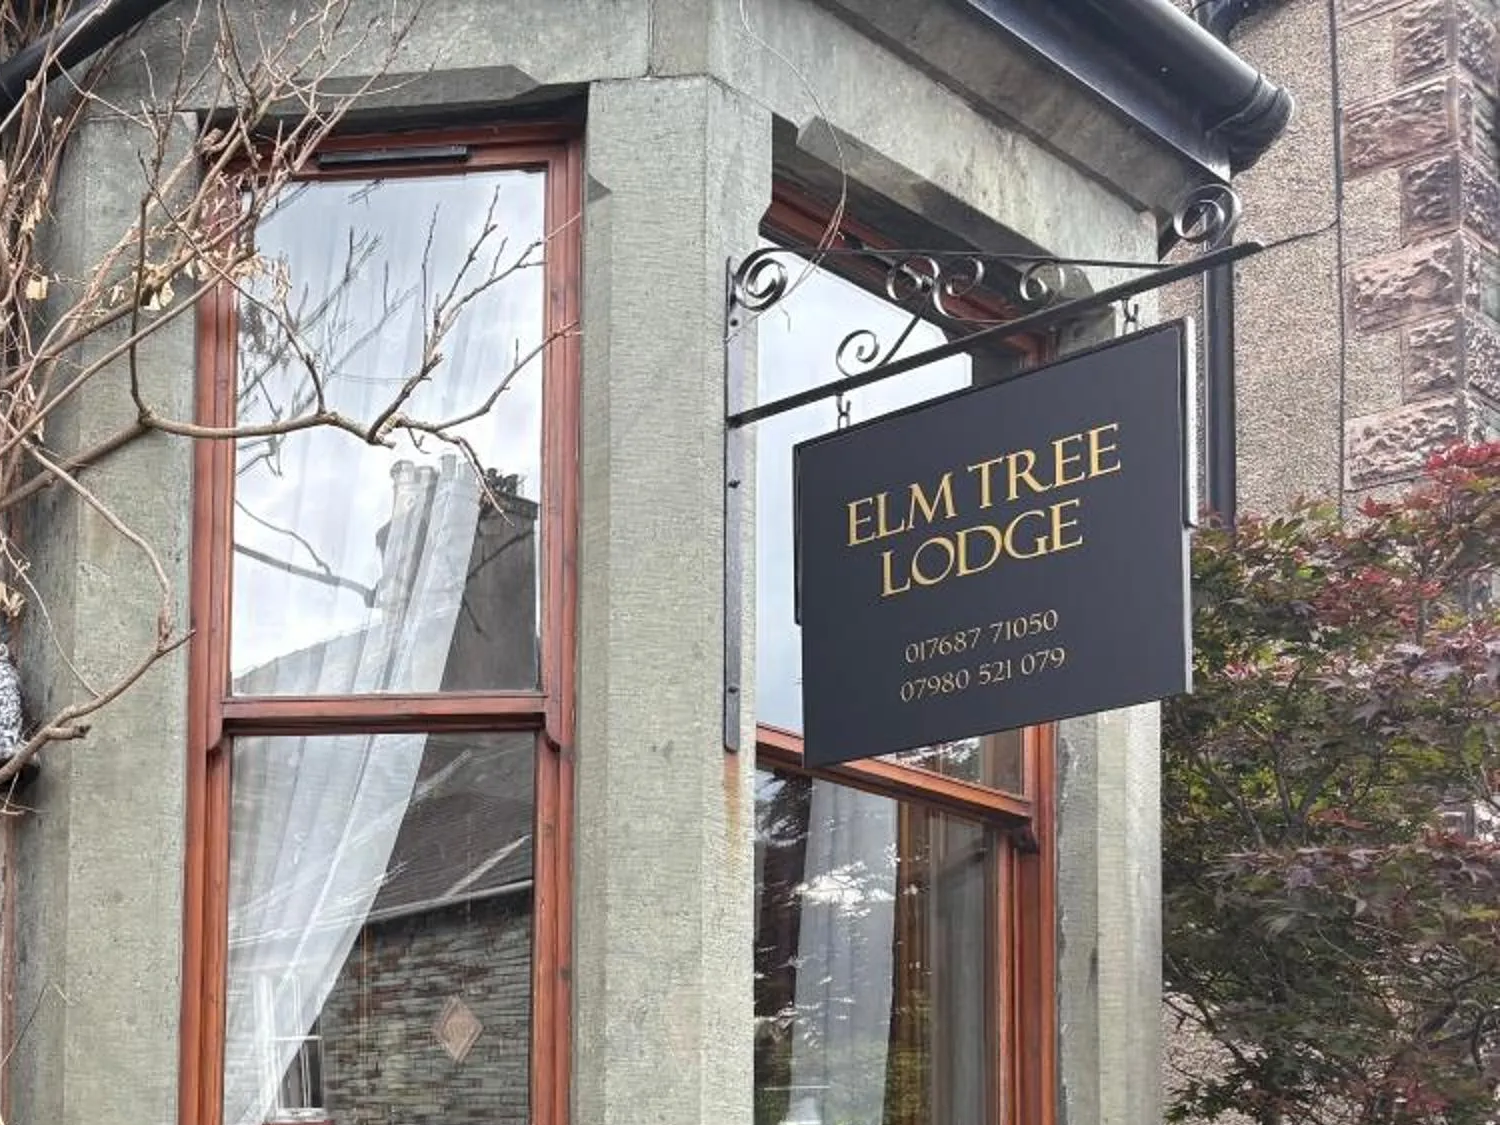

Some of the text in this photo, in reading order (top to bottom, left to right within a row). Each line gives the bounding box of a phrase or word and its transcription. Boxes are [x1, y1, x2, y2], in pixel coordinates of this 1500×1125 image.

[846, 423, 1122, 547] ELM TREE
[880, 499, 1084, 598] LODGE
[900, 647, 1066, 702] 07980 521 079
[905, 609, 1059, 664] 017687 71050
